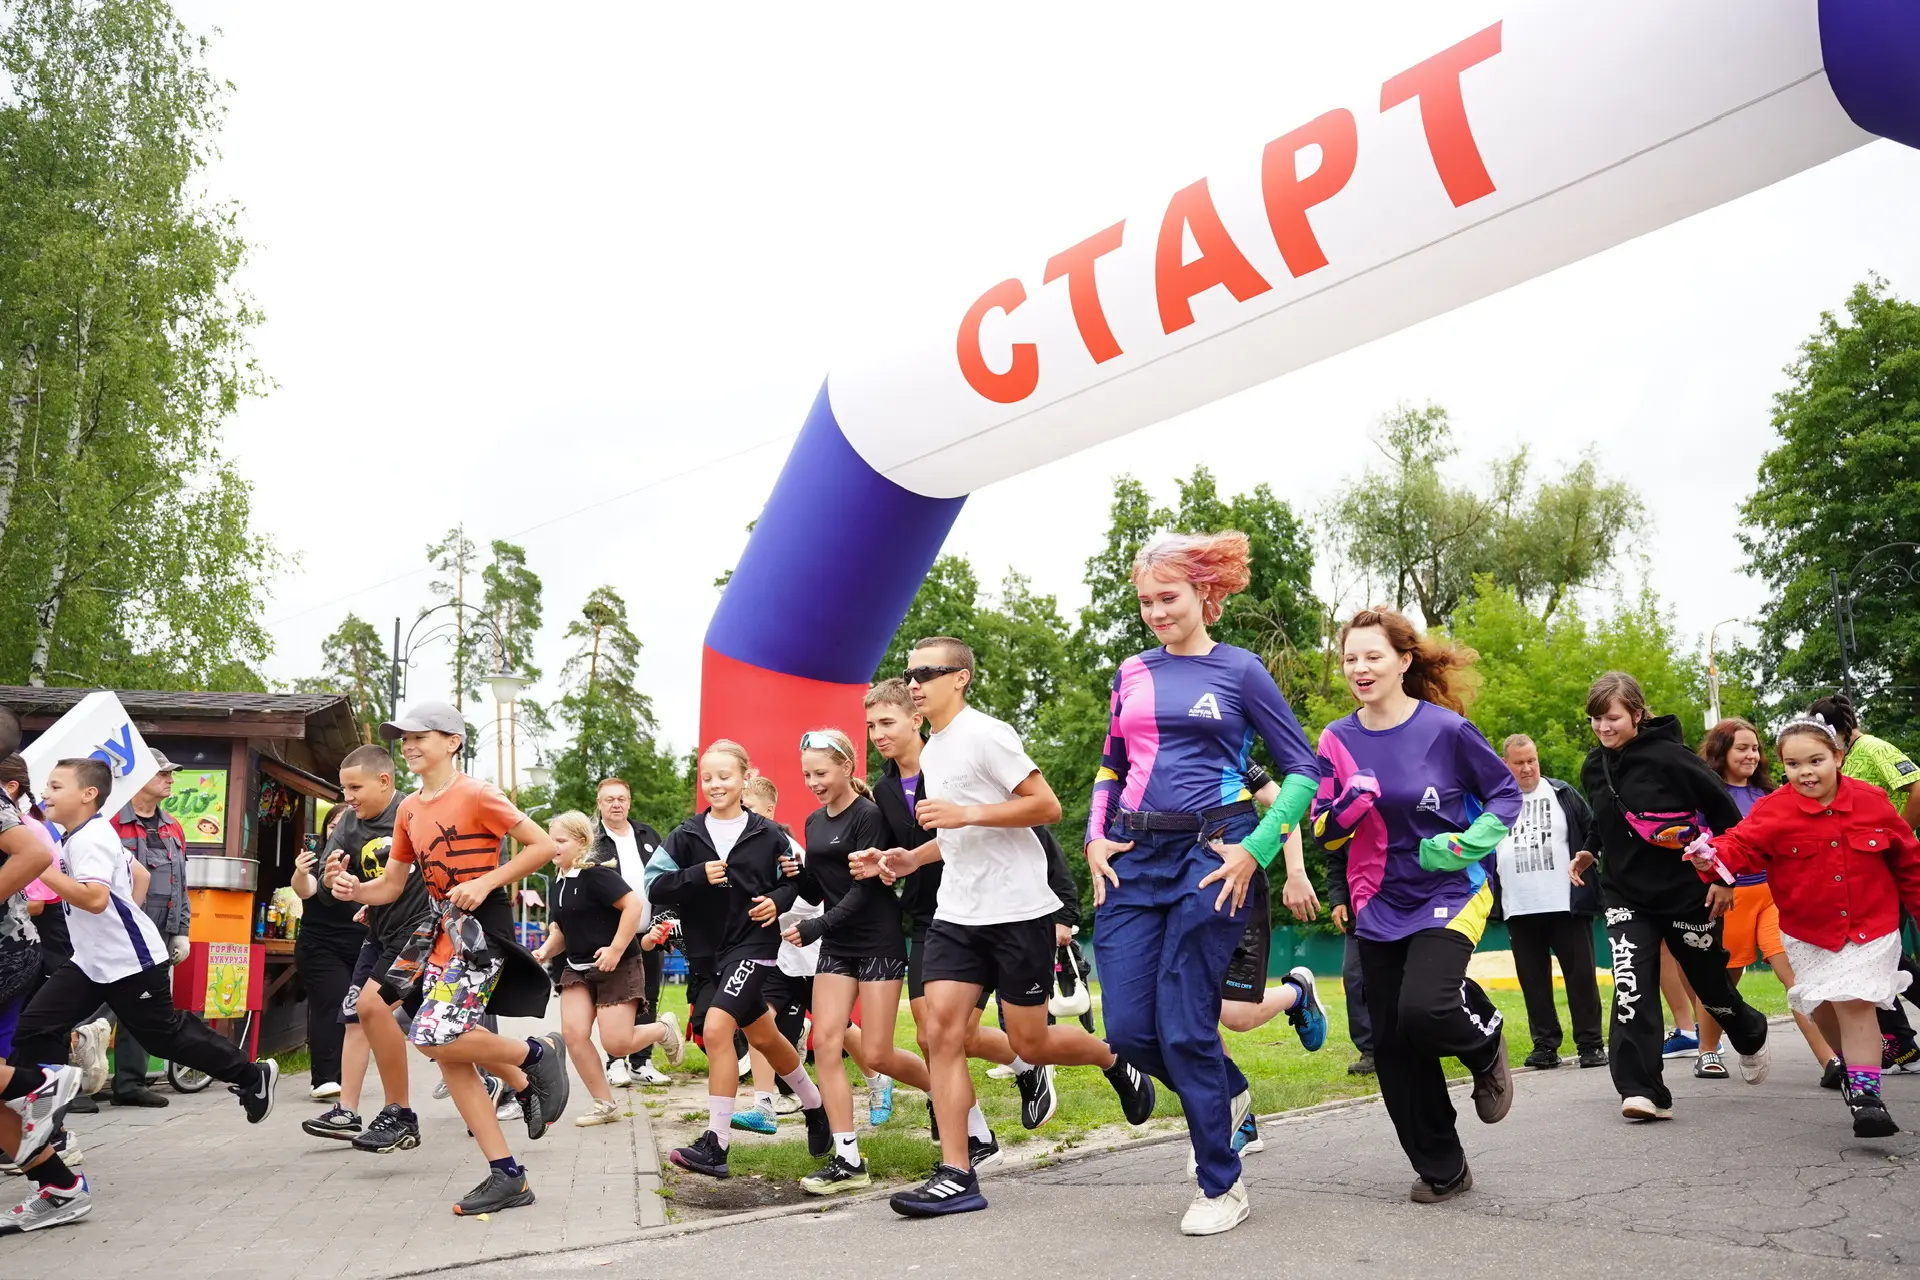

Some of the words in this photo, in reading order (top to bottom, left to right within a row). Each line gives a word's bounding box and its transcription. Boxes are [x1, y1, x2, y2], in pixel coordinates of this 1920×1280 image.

[957, 19, 1503, 404] СТАРТ
[209, 956, 248, 965] КУКУРУЗА
[210, 945, 248, 954] ГОРЯЧАЯ
[723, 959, 756, 997] Kap
